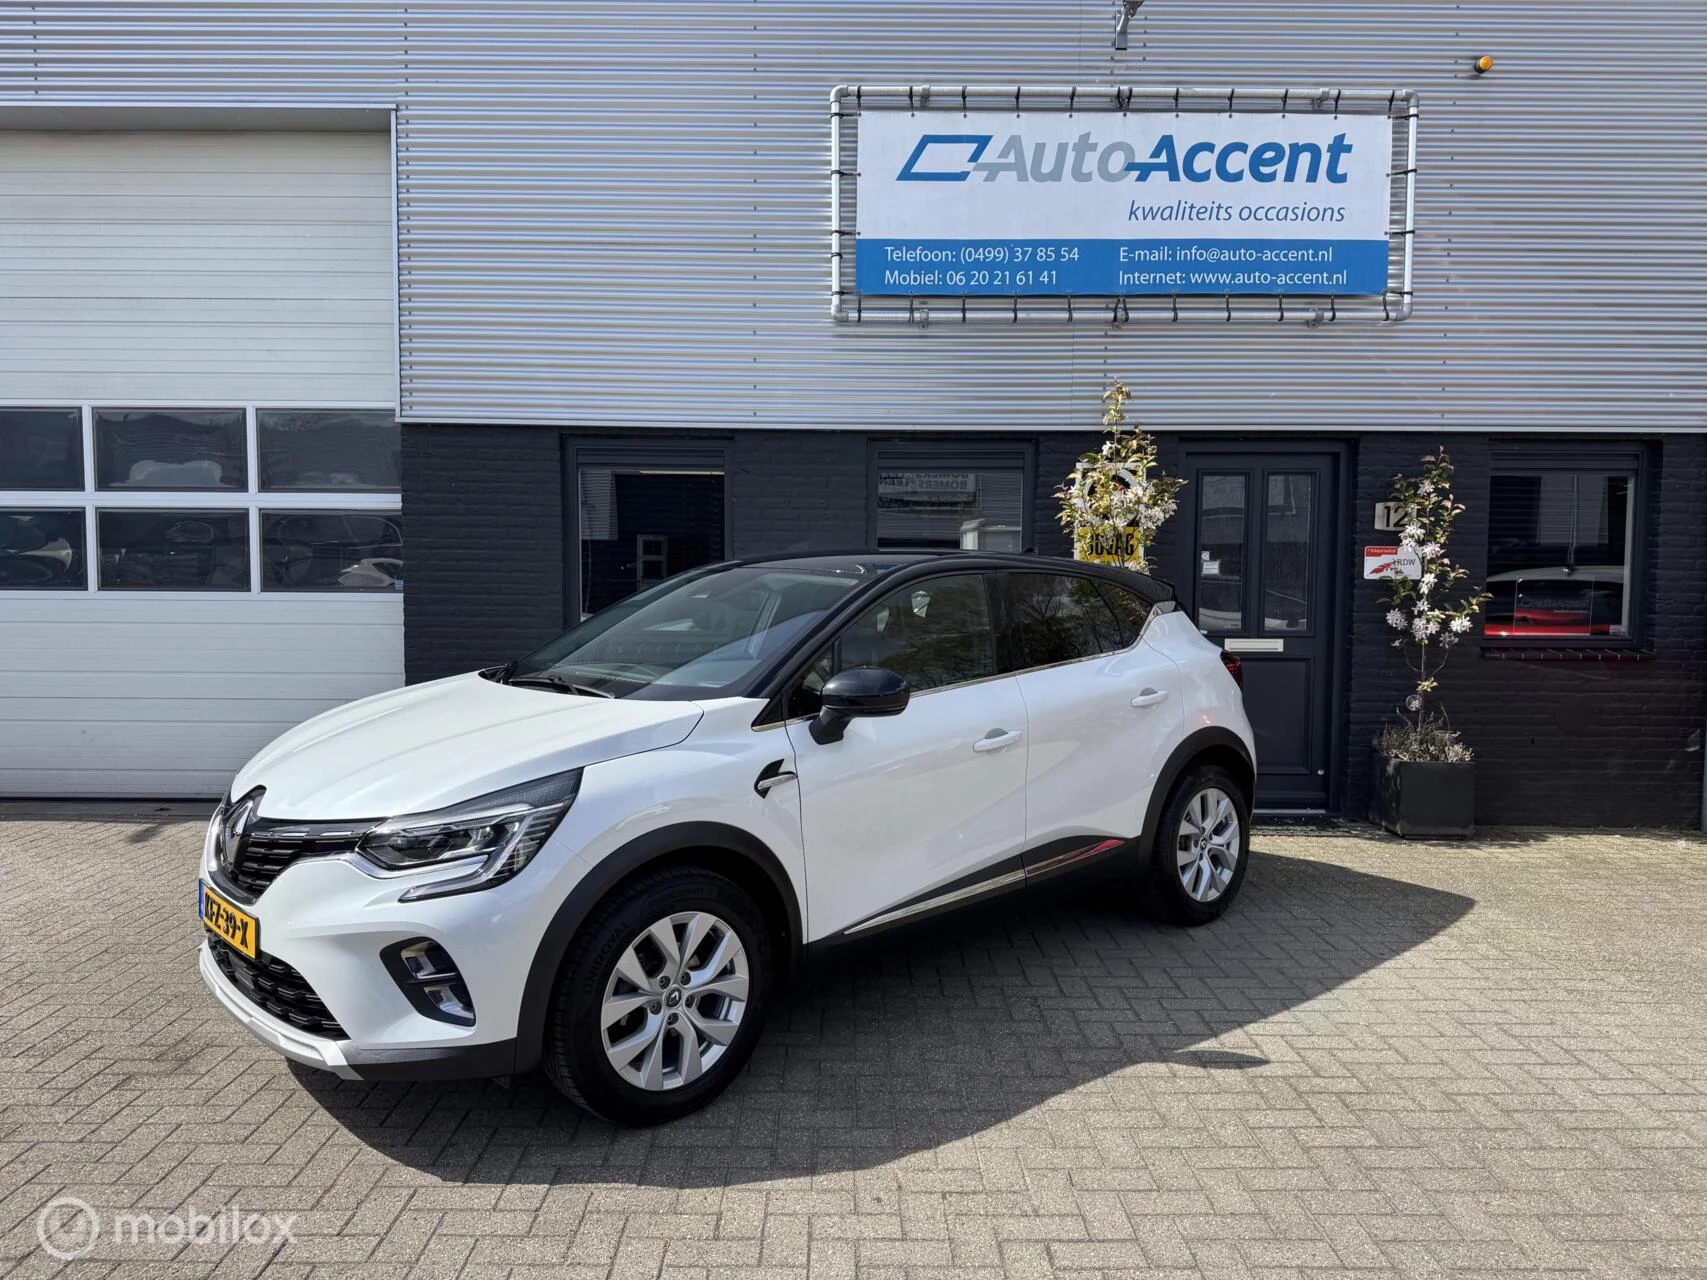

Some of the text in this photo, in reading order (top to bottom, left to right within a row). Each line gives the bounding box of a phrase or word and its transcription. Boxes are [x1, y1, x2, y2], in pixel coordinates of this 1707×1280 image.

[1128, 200, 1345, 222] kwaliteits occasions
[884, 246, 1079, 264] Telefoon: (0499) 37 85 54
[1119, 246, 1333, 263] E-mail: info@auto-accent.nl
[884, 269, 1056, 285] Mobiel: 06 20 21 61 41
[1119, 270, 1347, 285] Internet: www.auto-accent.nl
[1384, 505, 1409, 528] 12
[1396, 558, 1416, 566] RDW
[581, 921, 631, 994] UNIROYAL
